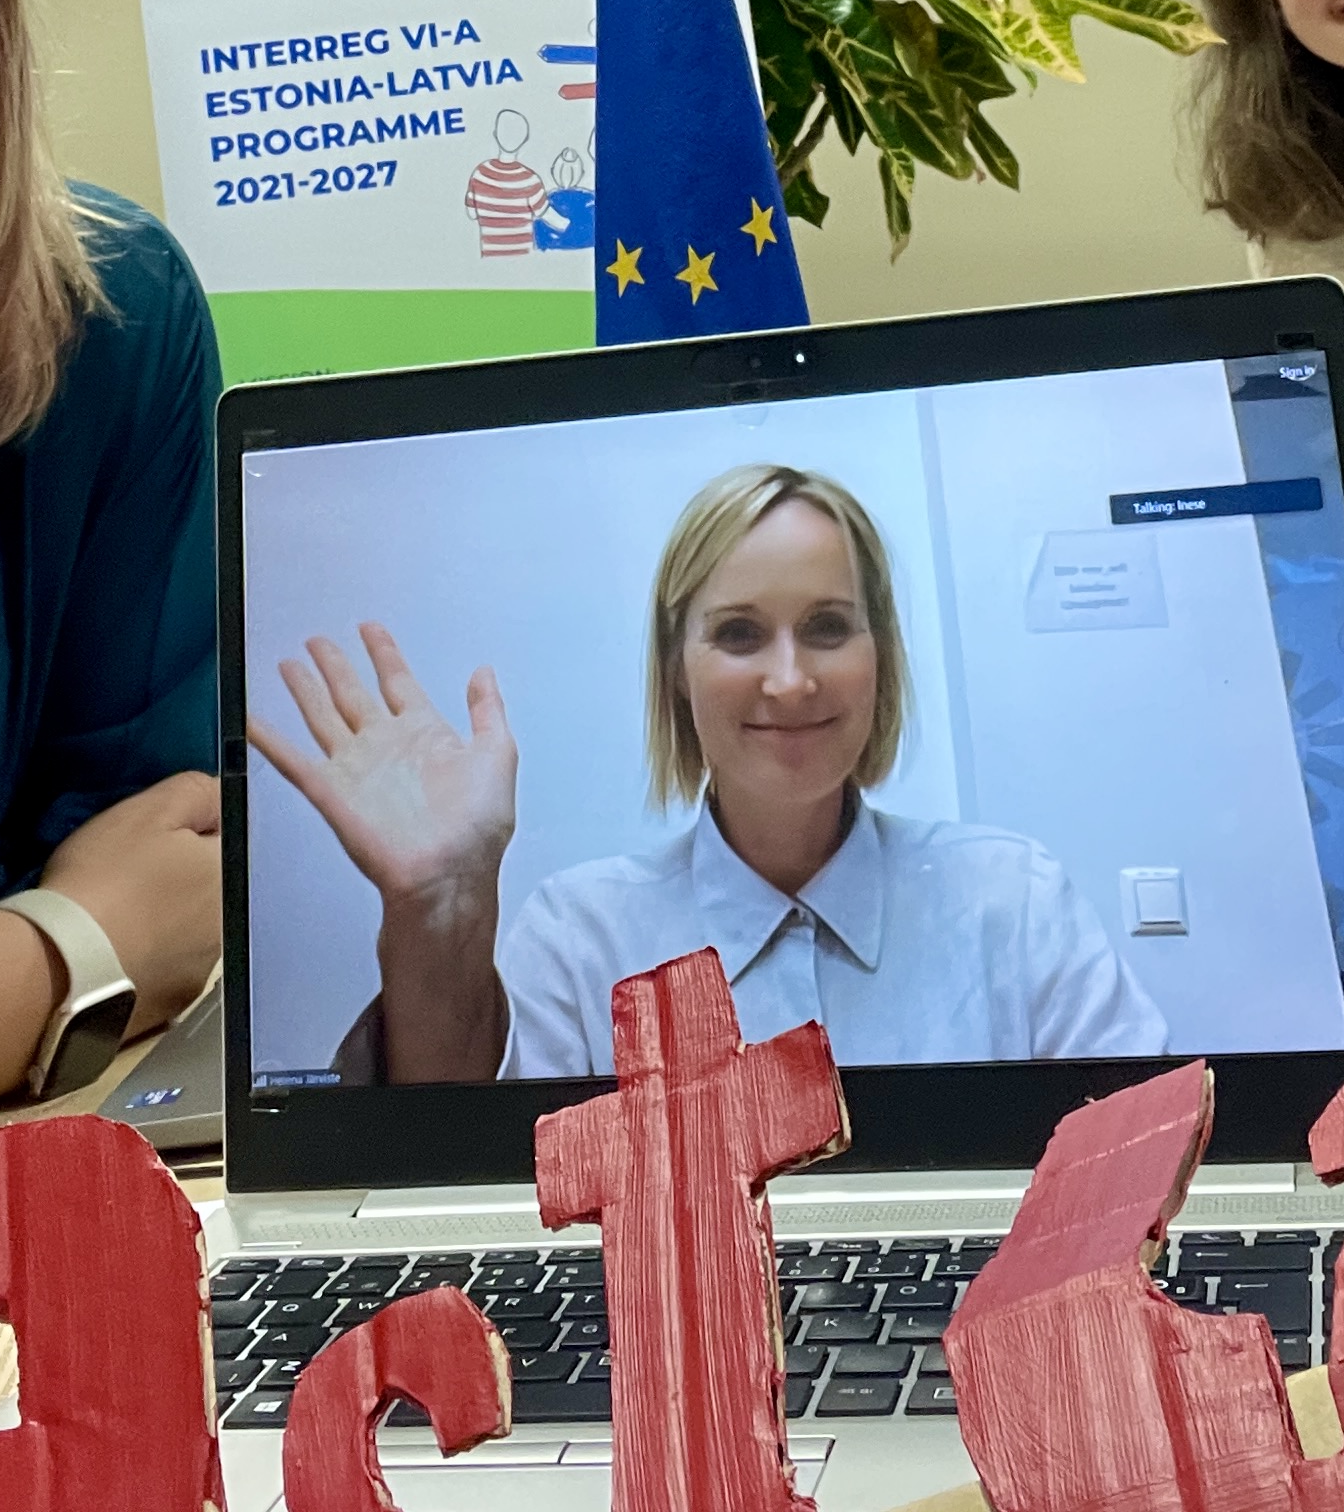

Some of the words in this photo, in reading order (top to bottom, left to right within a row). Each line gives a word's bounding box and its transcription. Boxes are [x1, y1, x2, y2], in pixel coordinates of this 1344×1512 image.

[201, 28, 391, 74] INTERREG
[400, 19, 481, 49] VI-A
[206, 58, 523, 118] ESTONIA-LATVIA
[210, 107, 466, 162] PROGRAMME
[213, 160, 398, 207] 2021-2027
[1279, 366, 1304, 378] Sign
[1132, 500, 1176, 516] Talking:
